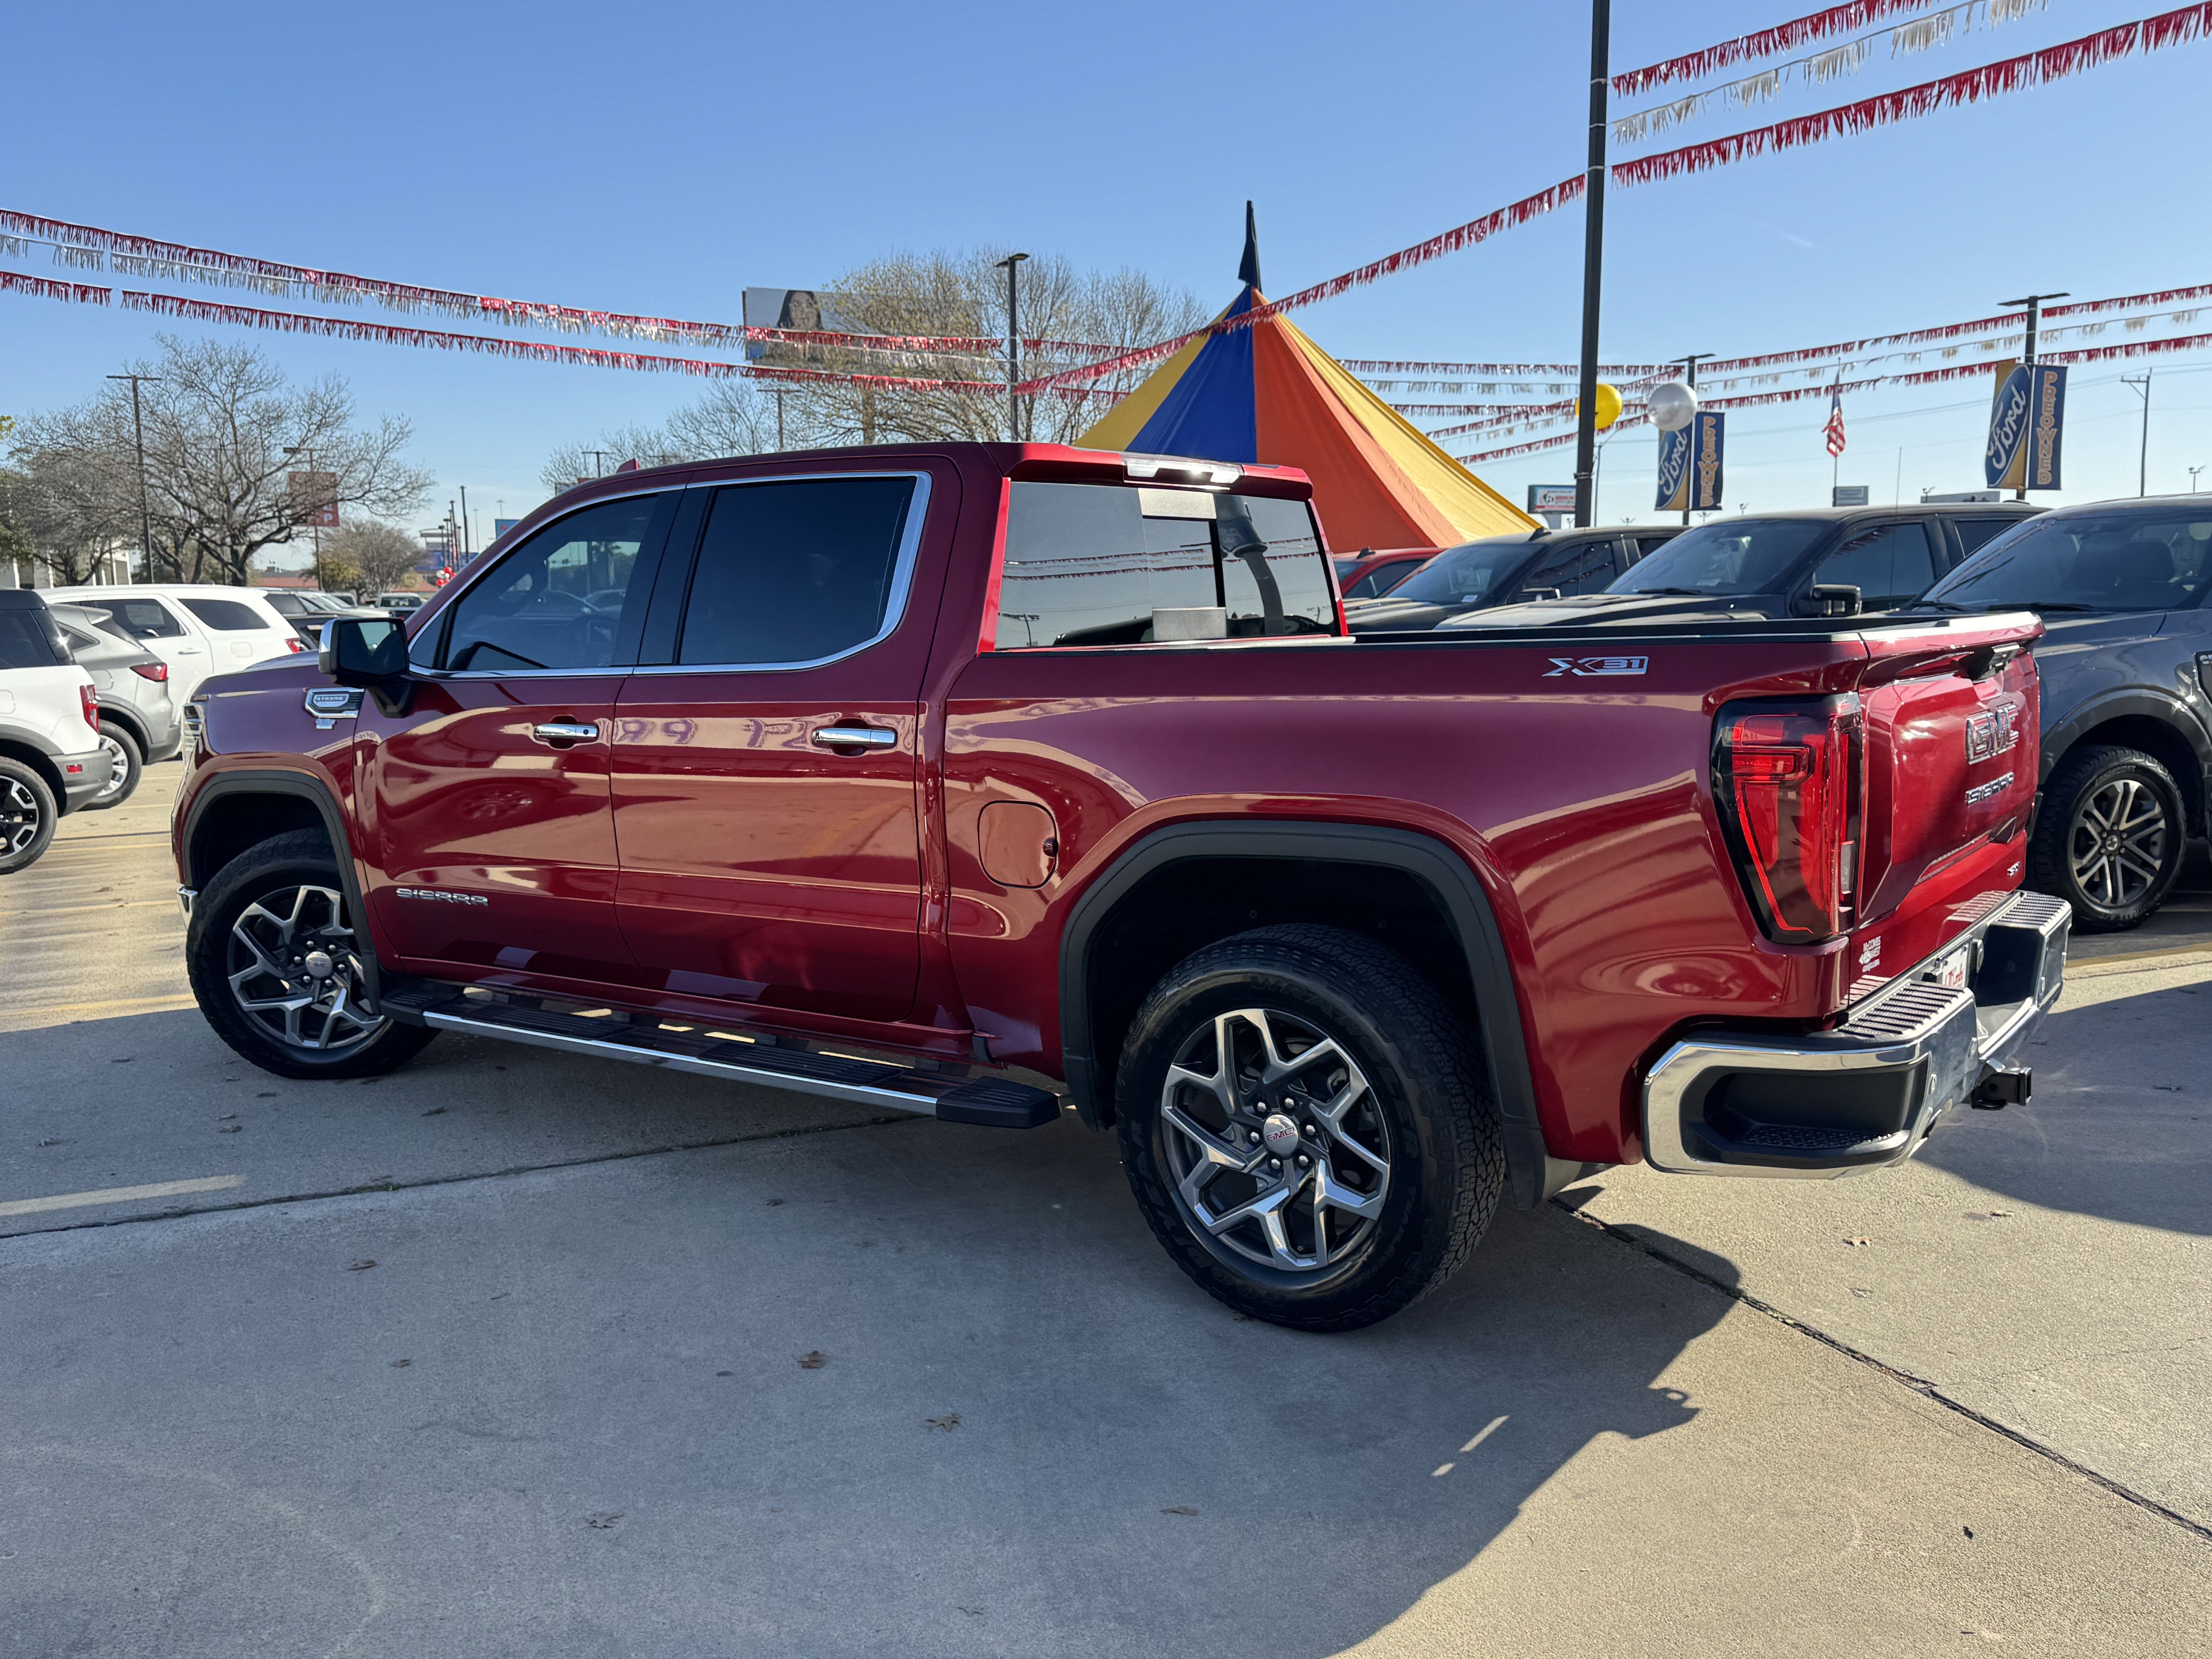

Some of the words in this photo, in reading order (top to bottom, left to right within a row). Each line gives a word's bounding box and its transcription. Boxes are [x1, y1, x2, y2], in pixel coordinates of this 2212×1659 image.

[1987, 384, 2026, 469] Ford
[2036, 371, 2057, 484] PREOWNED
[1659, 430, 1687, 495] Ford
[1698, 416, 1719, 507] PREOWNED
[1542, 656, 1649, 677] X31
[1965, 702, 2018, 764] GMC
[1965, 772, 2014, 806] SIERRA
[396, 888, 488, 907] SIERRA
[1266, 1127, 1295, 1141] GMC
